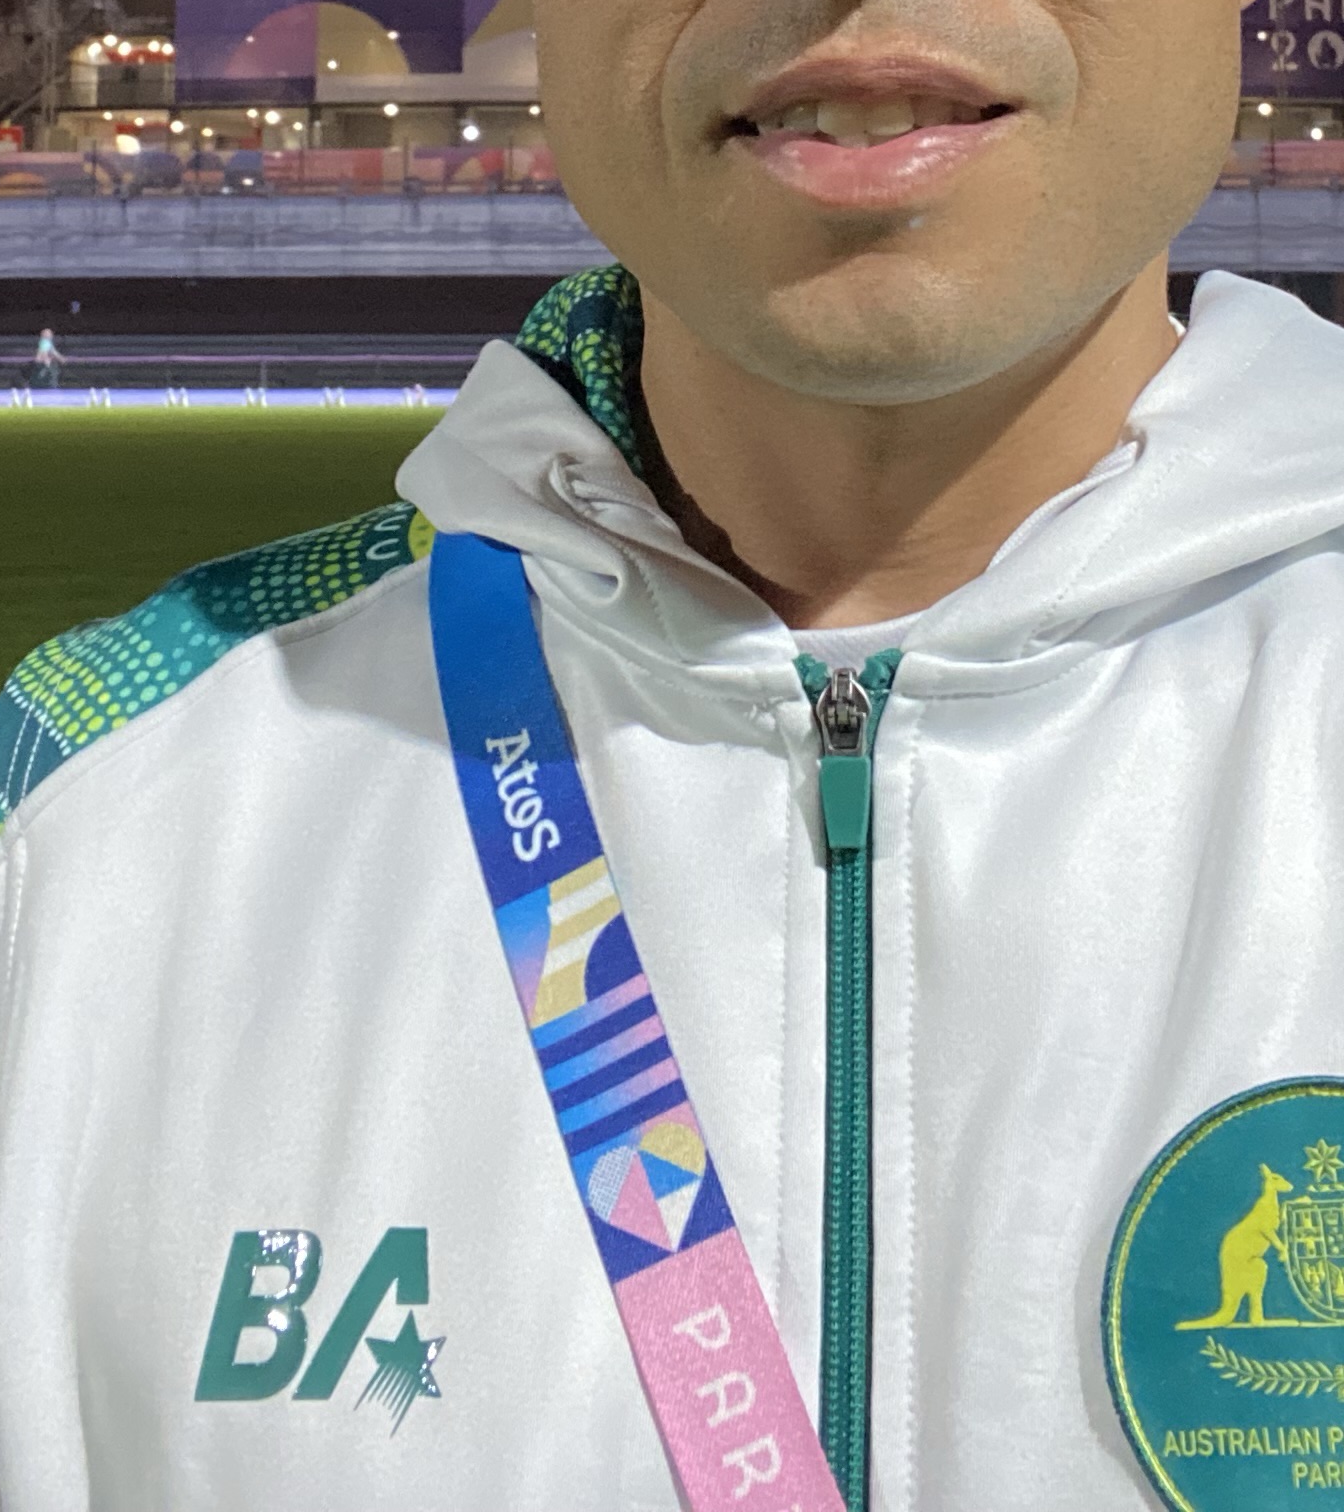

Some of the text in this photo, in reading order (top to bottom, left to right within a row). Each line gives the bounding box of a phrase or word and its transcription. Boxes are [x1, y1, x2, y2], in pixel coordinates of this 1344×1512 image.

[485, 728, 561, 862] Atos
[194, 1226, 446, 1403] BA
[672, 1302, 803, 1512] PAR
[1163, 1426, 1322, 1458] AUSTRALIAN
